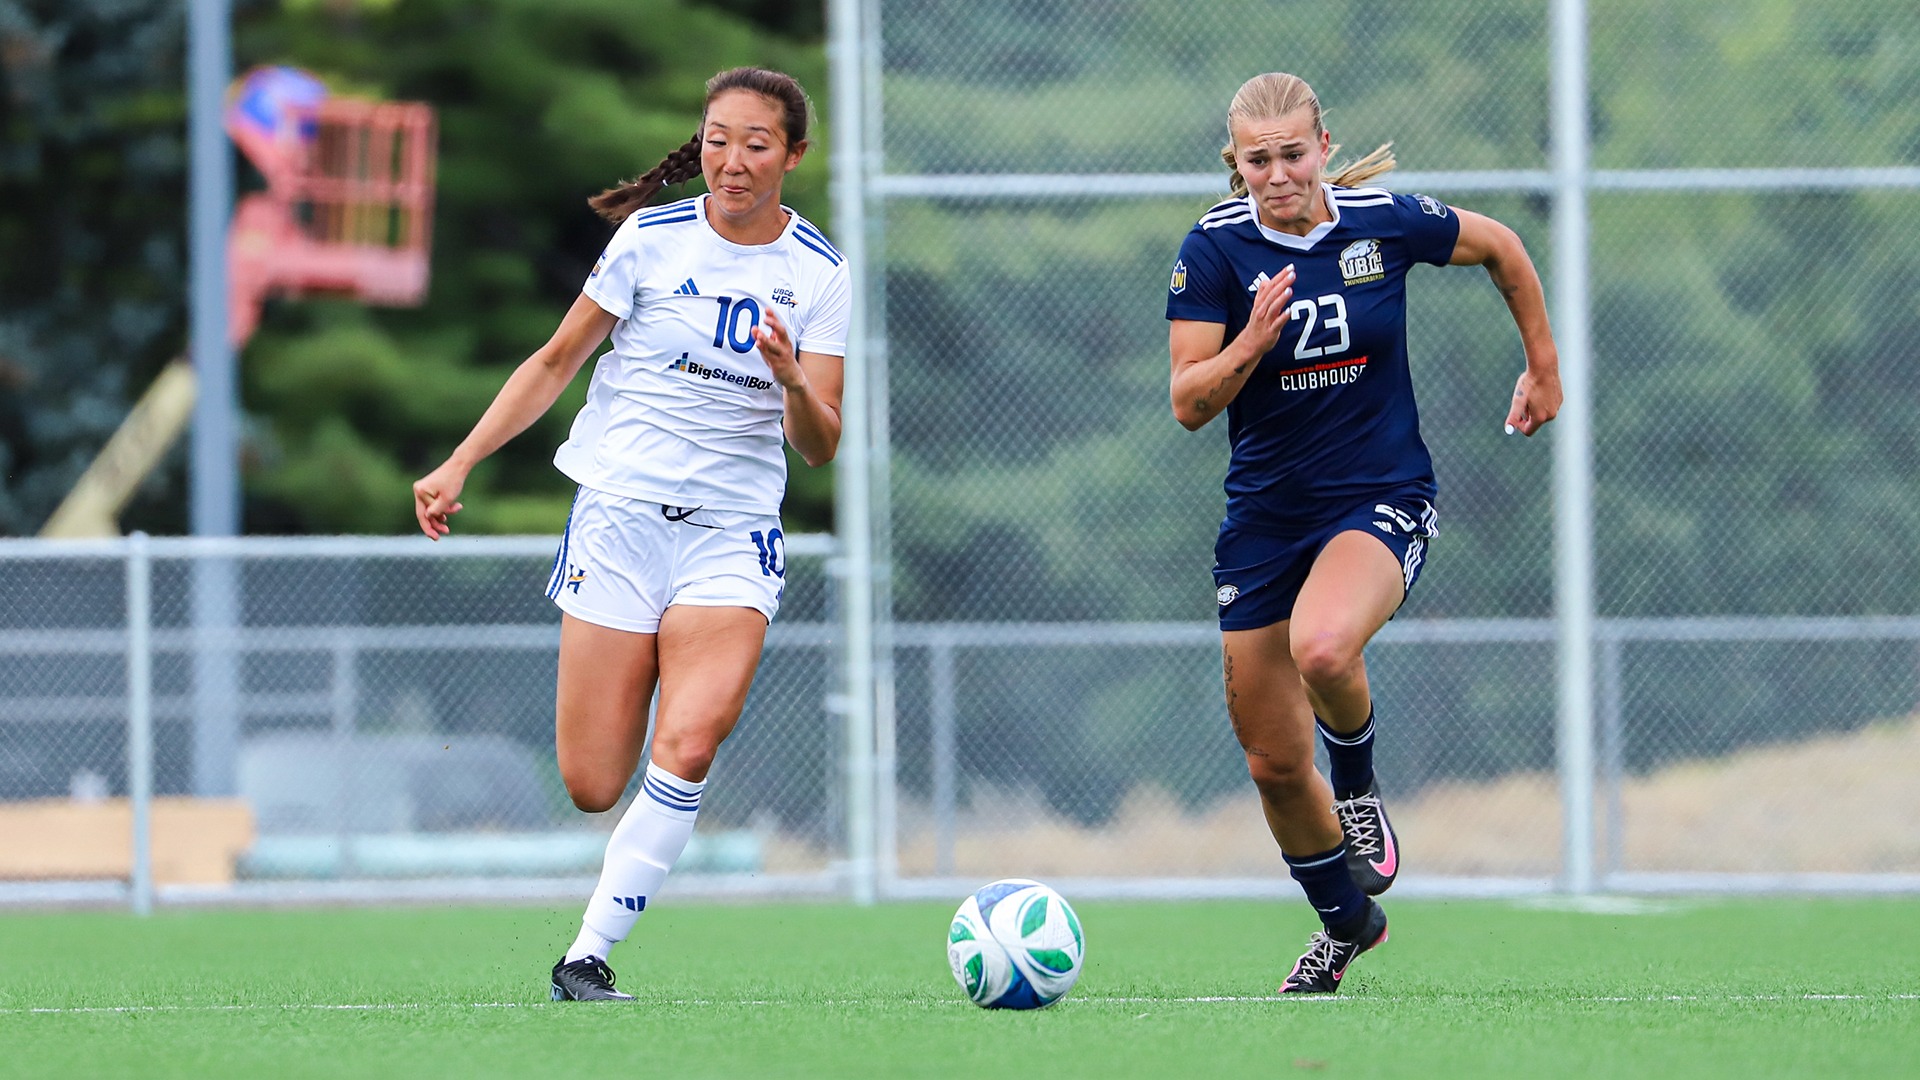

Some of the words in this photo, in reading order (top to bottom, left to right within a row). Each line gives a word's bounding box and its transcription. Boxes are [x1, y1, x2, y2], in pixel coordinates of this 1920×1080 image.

[1338, 252, 1384, 279] UBC
[773, 287, 794, 298] UBCO
[713, 296, 760, 354] 10
[1291, 294, 1351, 361] 23
[688, 362, 774, 390] BigSteelBox
[750, 527, 785, 579] 10
